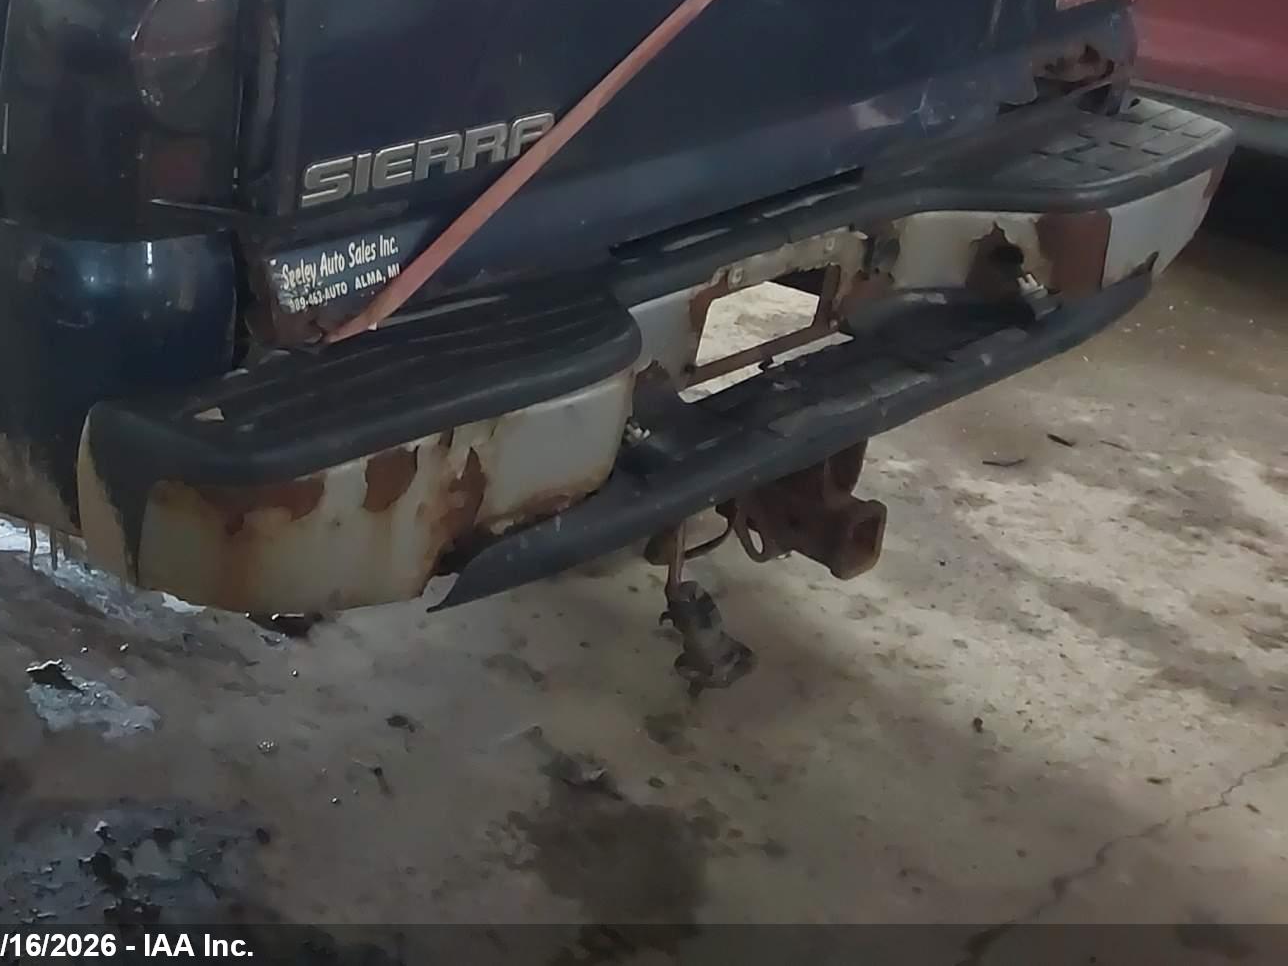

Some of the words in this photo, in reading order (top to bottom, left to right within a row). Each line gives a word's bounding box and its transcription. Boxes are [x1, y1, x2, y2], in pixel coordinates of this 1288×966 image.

[301, 113, 555, 208] SIERRA
[282, 259, 317, 290] Seeley
[320, 252, 345, 277] Auto
[348, 240, 376, 268] Sales
[380, 235, 399, 256] Inc.
[355, 269, 386, 290] ALMA,
[388, 263, 400, 280] MI
